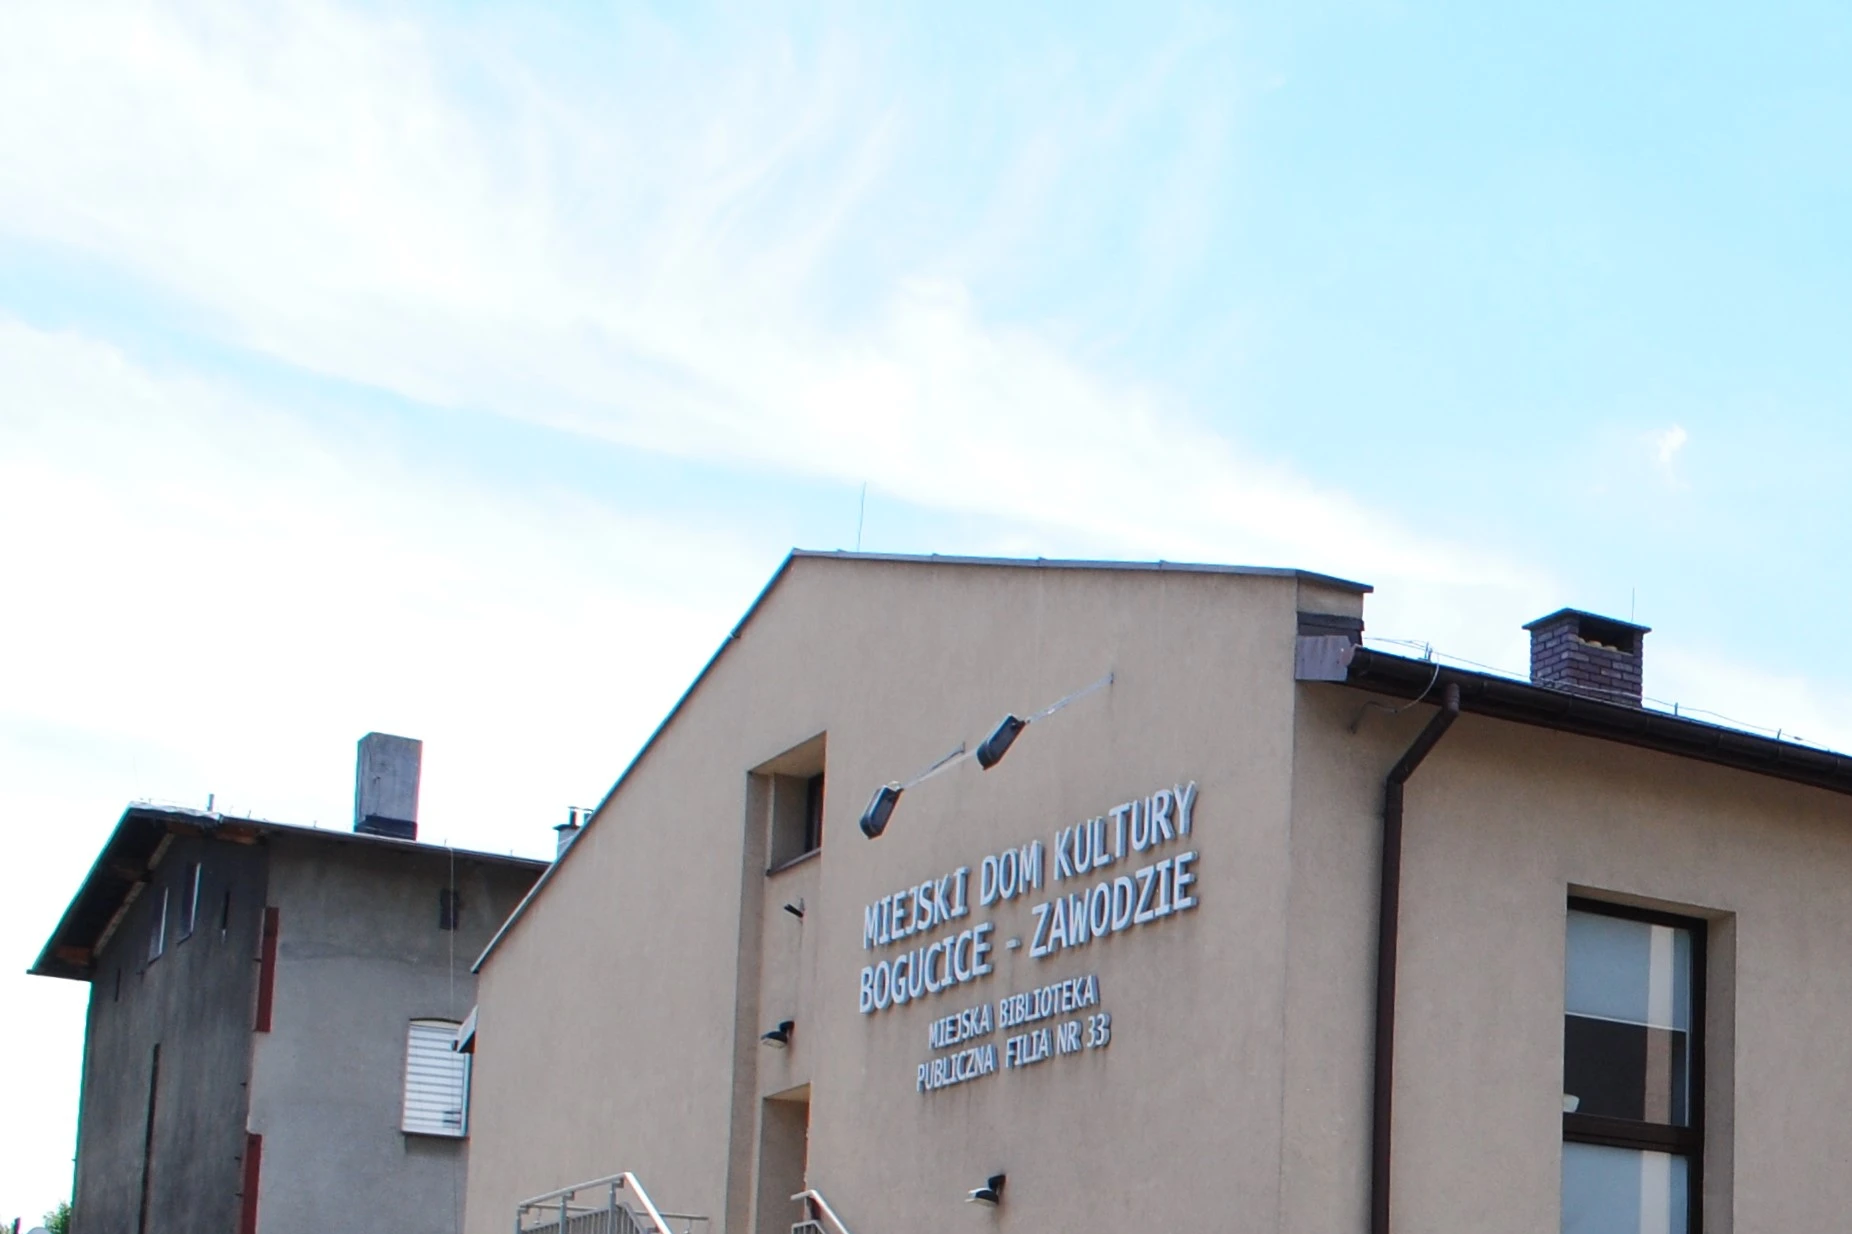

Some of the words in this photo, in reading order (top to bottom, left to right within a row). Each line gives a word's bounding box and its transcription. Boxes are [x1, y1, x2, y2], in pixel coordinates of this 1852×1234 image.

[864, 866, 970, 949] MIEJSKI
[980, 840, 1044, 906] DOM
[1054, 780, 1198, 881] KULTURY
[860, 922, 993, 1014] BOGUCICE
[1029, 851, 1198, 958] ZAWODZIE
[917, 1044, 998, 1092] PUBLICZNA
[1005, 1028, 1053, 1068] FILIA
[1057, 1021, 1082, 1055] NR
[1087, 1013, 1111, 1048] 33
[929, 1003, 994, 1049] MIEJSKA
[999, 975, 1099, 1029] BIBLIOTEKA
